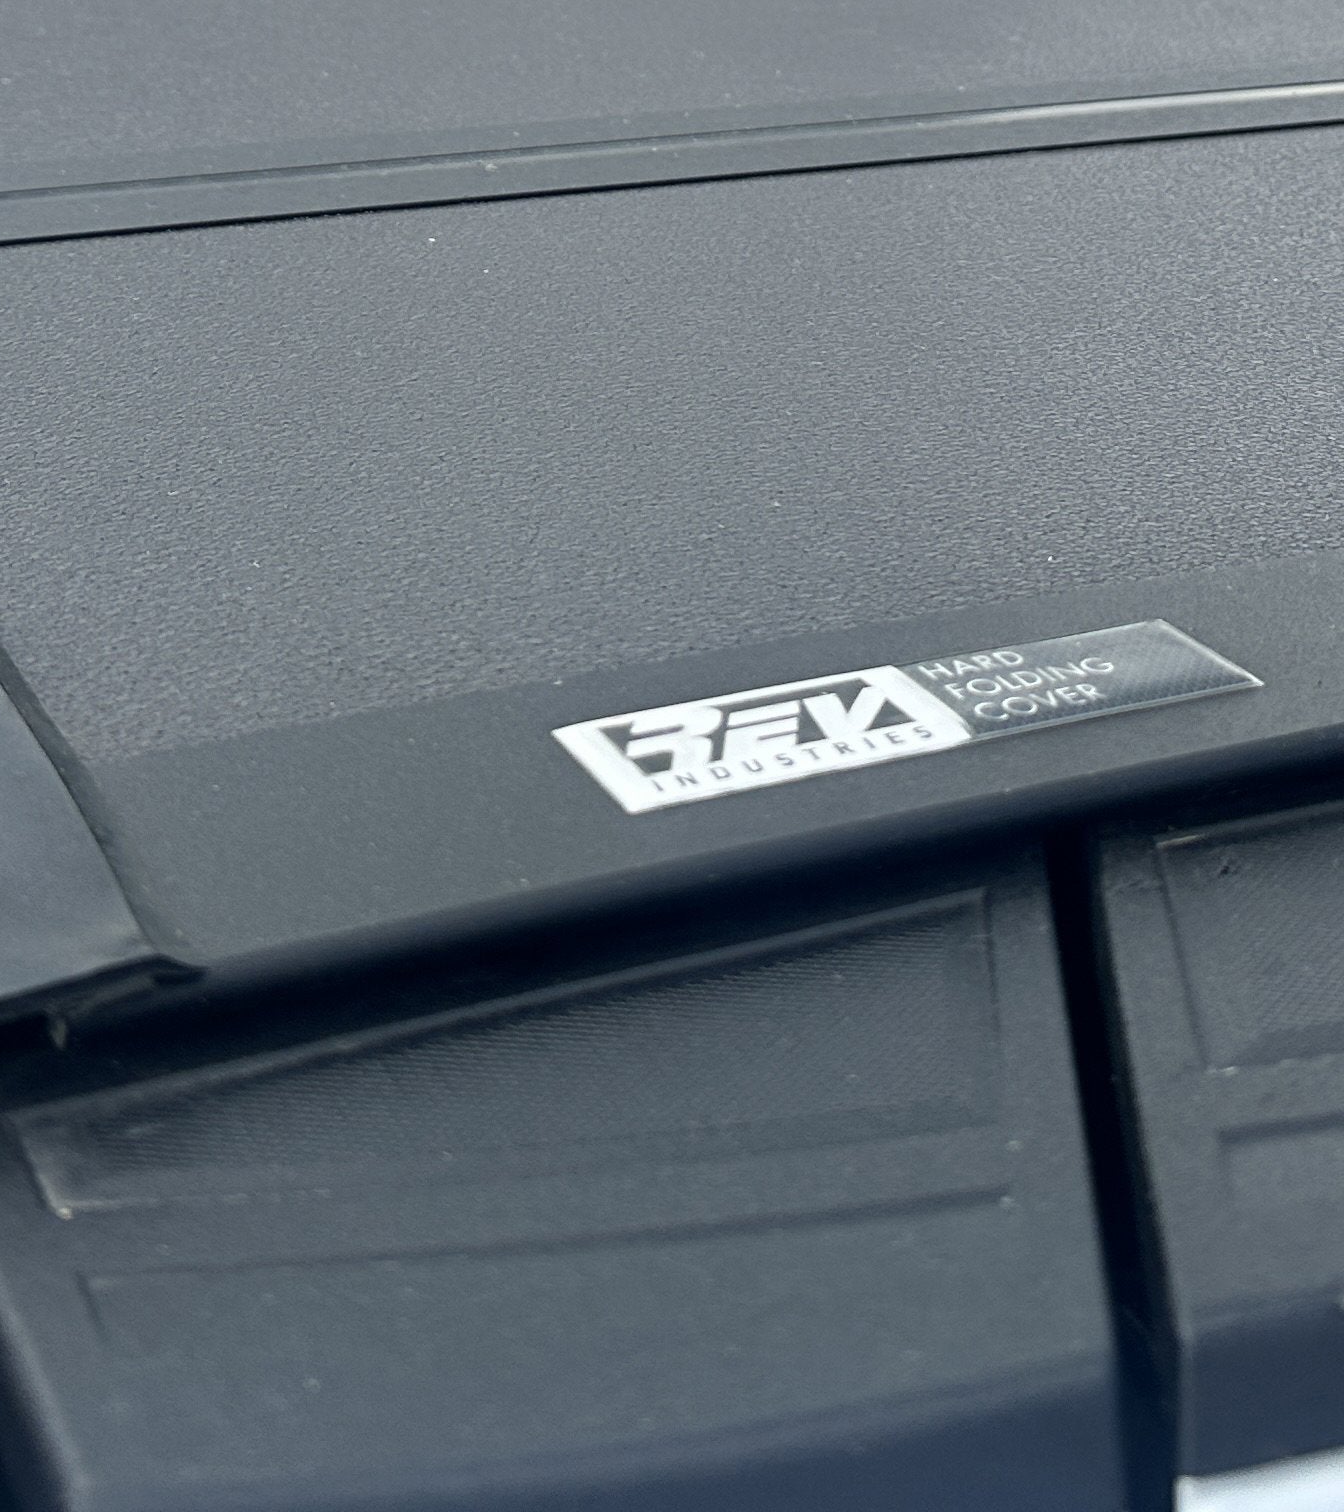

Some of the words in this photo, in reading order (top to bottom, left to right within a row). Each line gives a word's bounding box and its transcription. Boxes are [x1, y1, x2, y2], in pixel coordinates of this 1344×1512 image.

[918, 650, 1024, 680] HARD
[943, 656, 1115, 701] FOLDING
[973, 683, 1106, 721] COVER
[653, 726, 935, 792] INDUSTRIES
